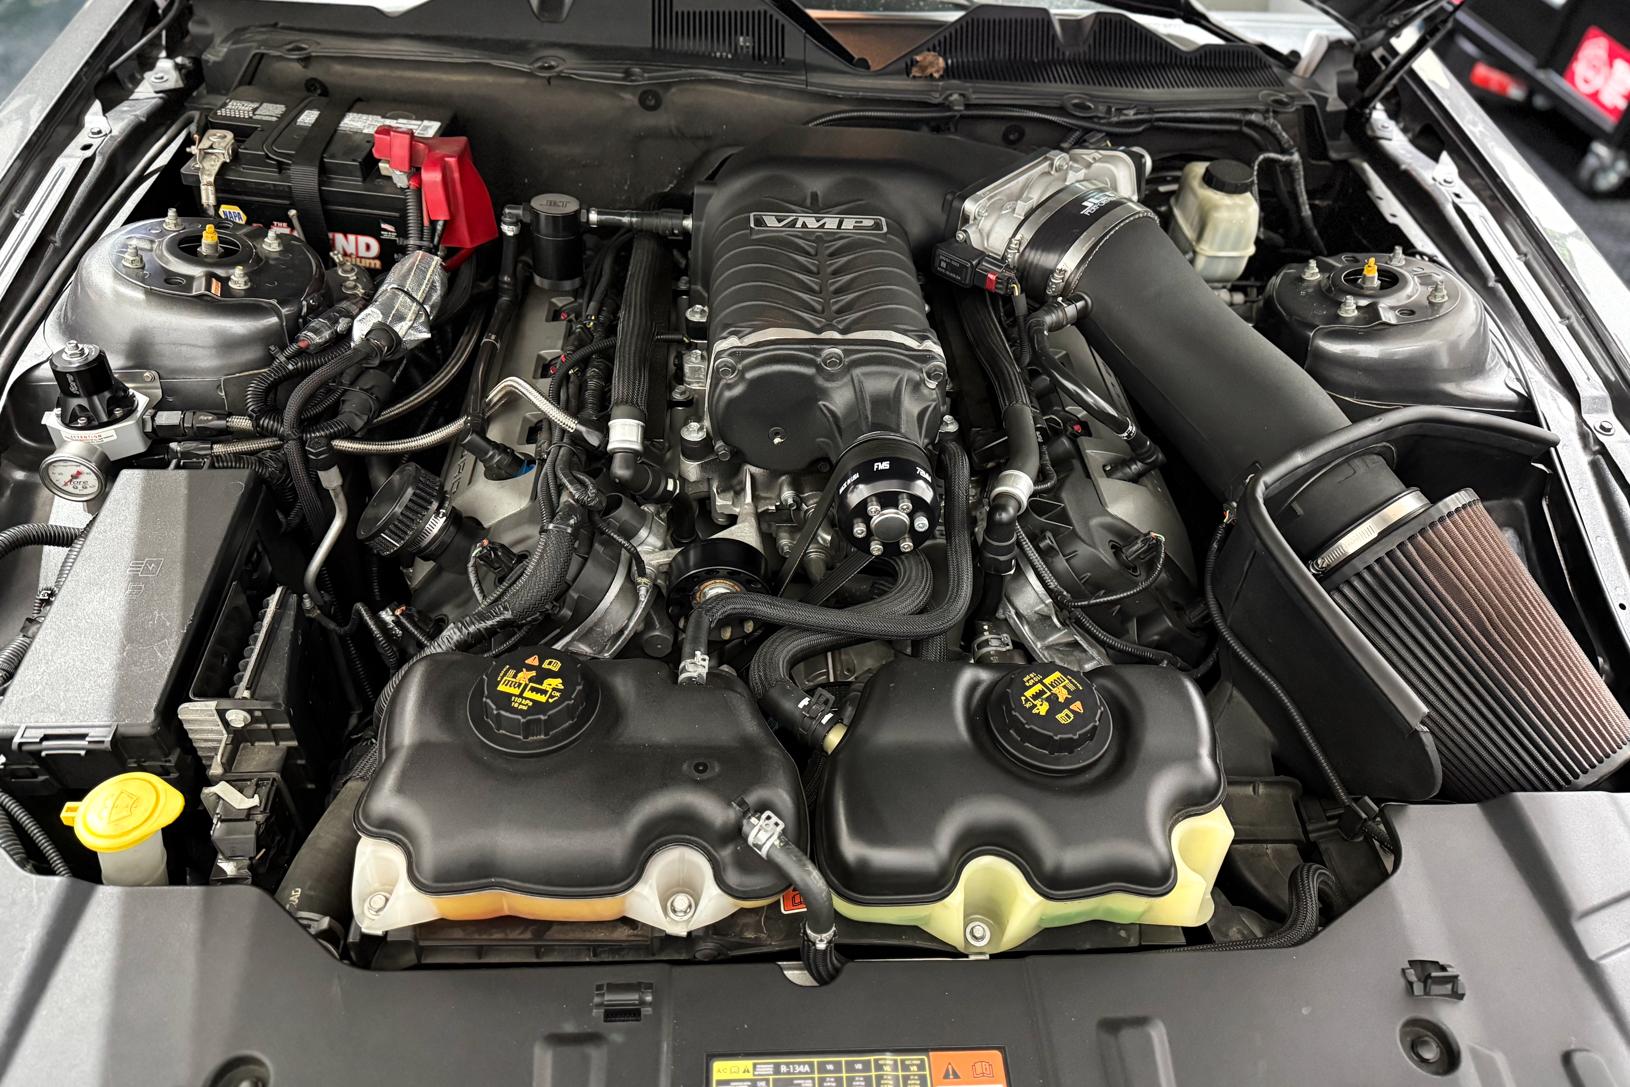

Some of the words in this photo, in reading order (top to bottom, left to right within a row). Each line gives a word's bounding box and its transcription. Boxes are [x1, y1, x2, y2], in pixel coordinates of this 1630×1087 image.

[222, 210, 244, 222] NAPA
[762, 215, 876, 230] VMP
[873, 461, 890, 471] FMS
[780, 1064, 811, 1073] R-134A
